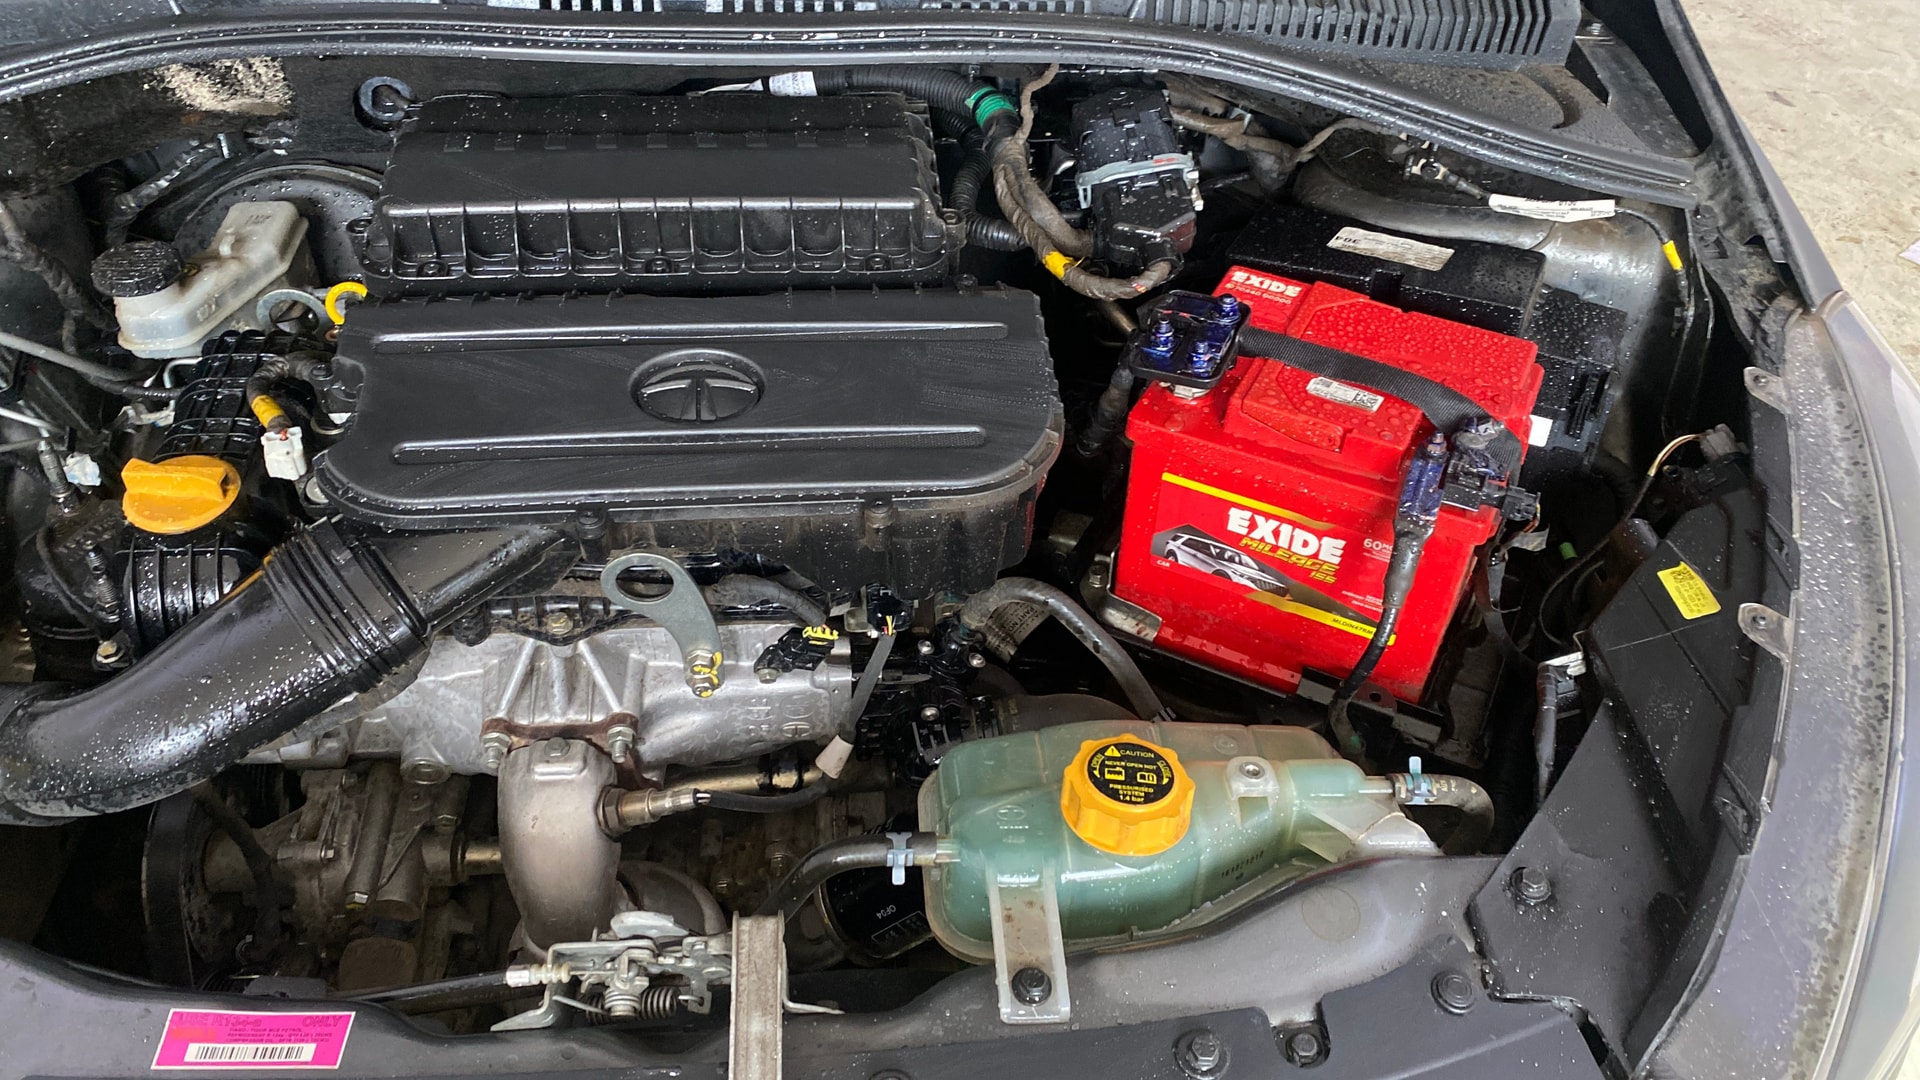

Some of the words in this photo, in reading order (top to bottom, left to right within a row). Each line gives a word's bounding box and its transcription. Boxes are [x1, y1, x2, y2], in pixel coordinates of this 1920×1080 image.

[1231, 271, 1302, 297] EXIDE
[1226, 507, 1347, 565] EXIDE
[1239, 537, 1340, 576] MILEAGE
[1120, 750, 1154, 758] CAUTION
[302, 1015, 344, 1027] ONLY
